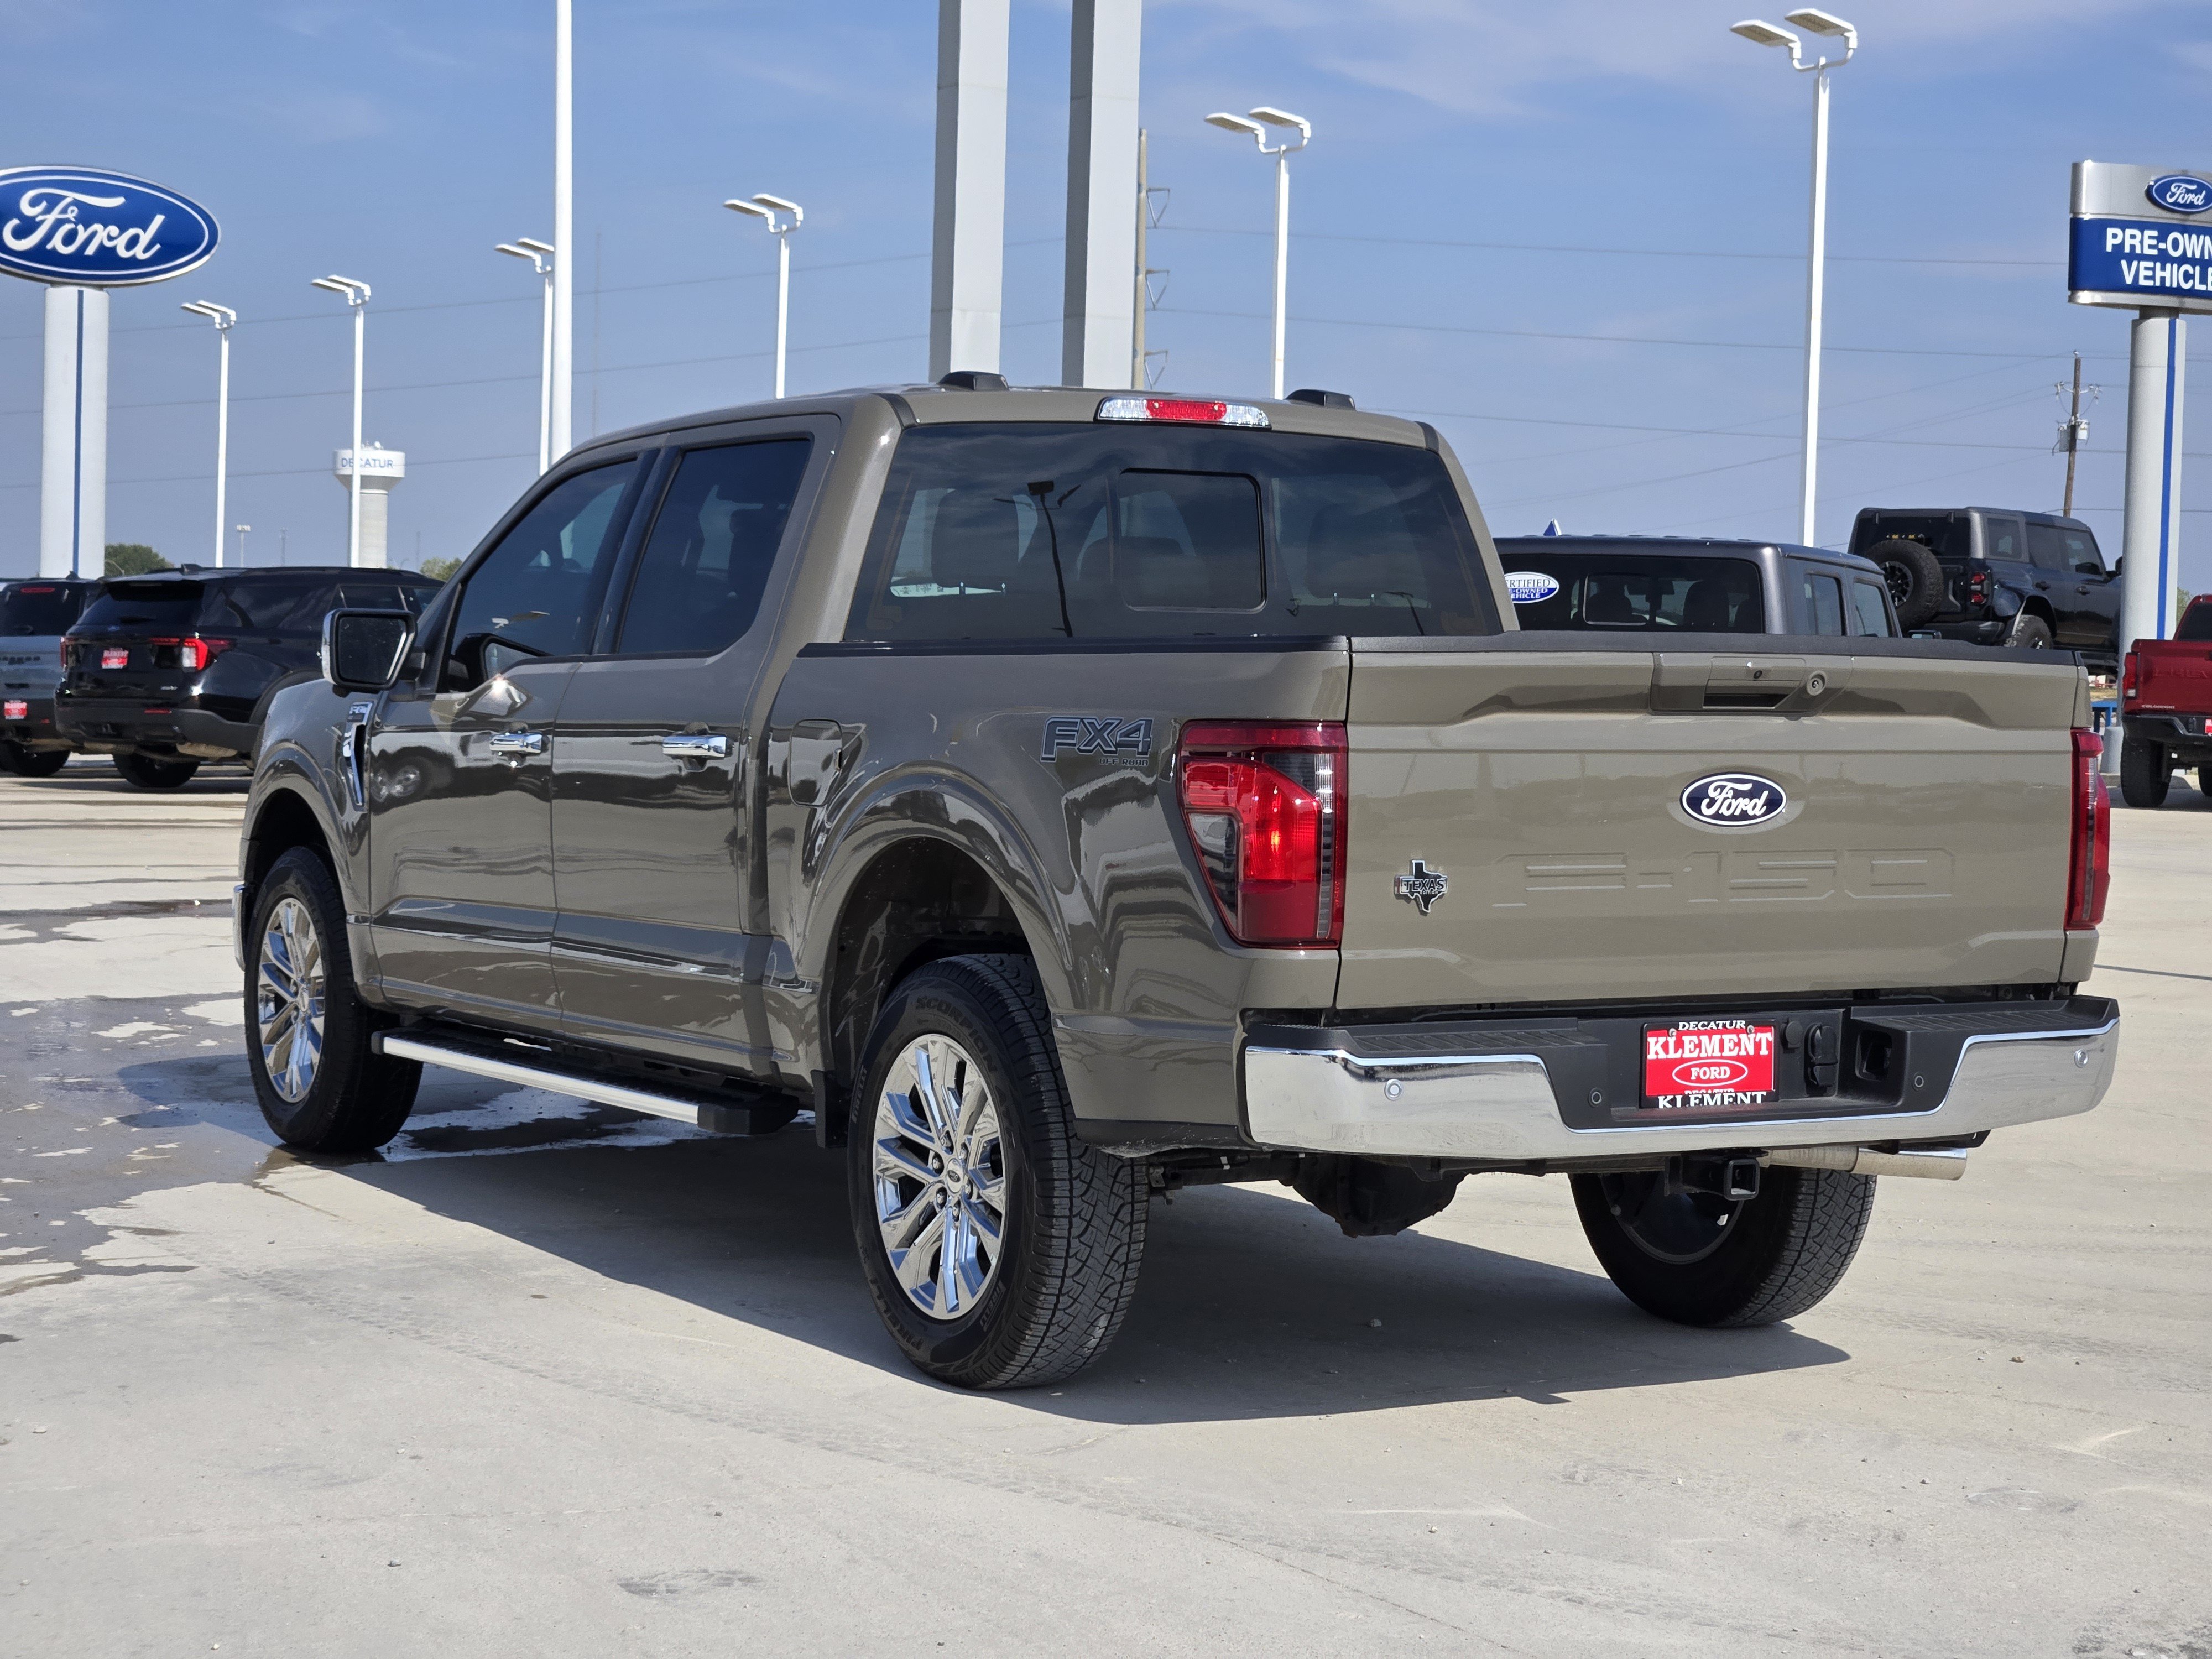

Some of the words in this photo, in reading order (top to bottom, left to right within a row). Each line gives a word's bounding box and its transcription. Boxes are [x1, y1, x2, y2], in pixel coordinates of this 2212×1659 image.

[2166, 182, 2206, 205] Ford
[3, 188, 165, 260] Ford
[1507, 579, 1551, 587] RTIFIED
[1040, 716, 1155, 763] FX4
[1122, 758, 1149, 766] ROAD
[1700, 781, 1769, 816] Ford
[1402, 879, 1444, 891] TEXAS
[1678, 1020, 1746, 1031] DECATUR
[1647, 1032, 1772, 1060] KLEMENT
[1691, 1066, 1730, 1079] FORD
